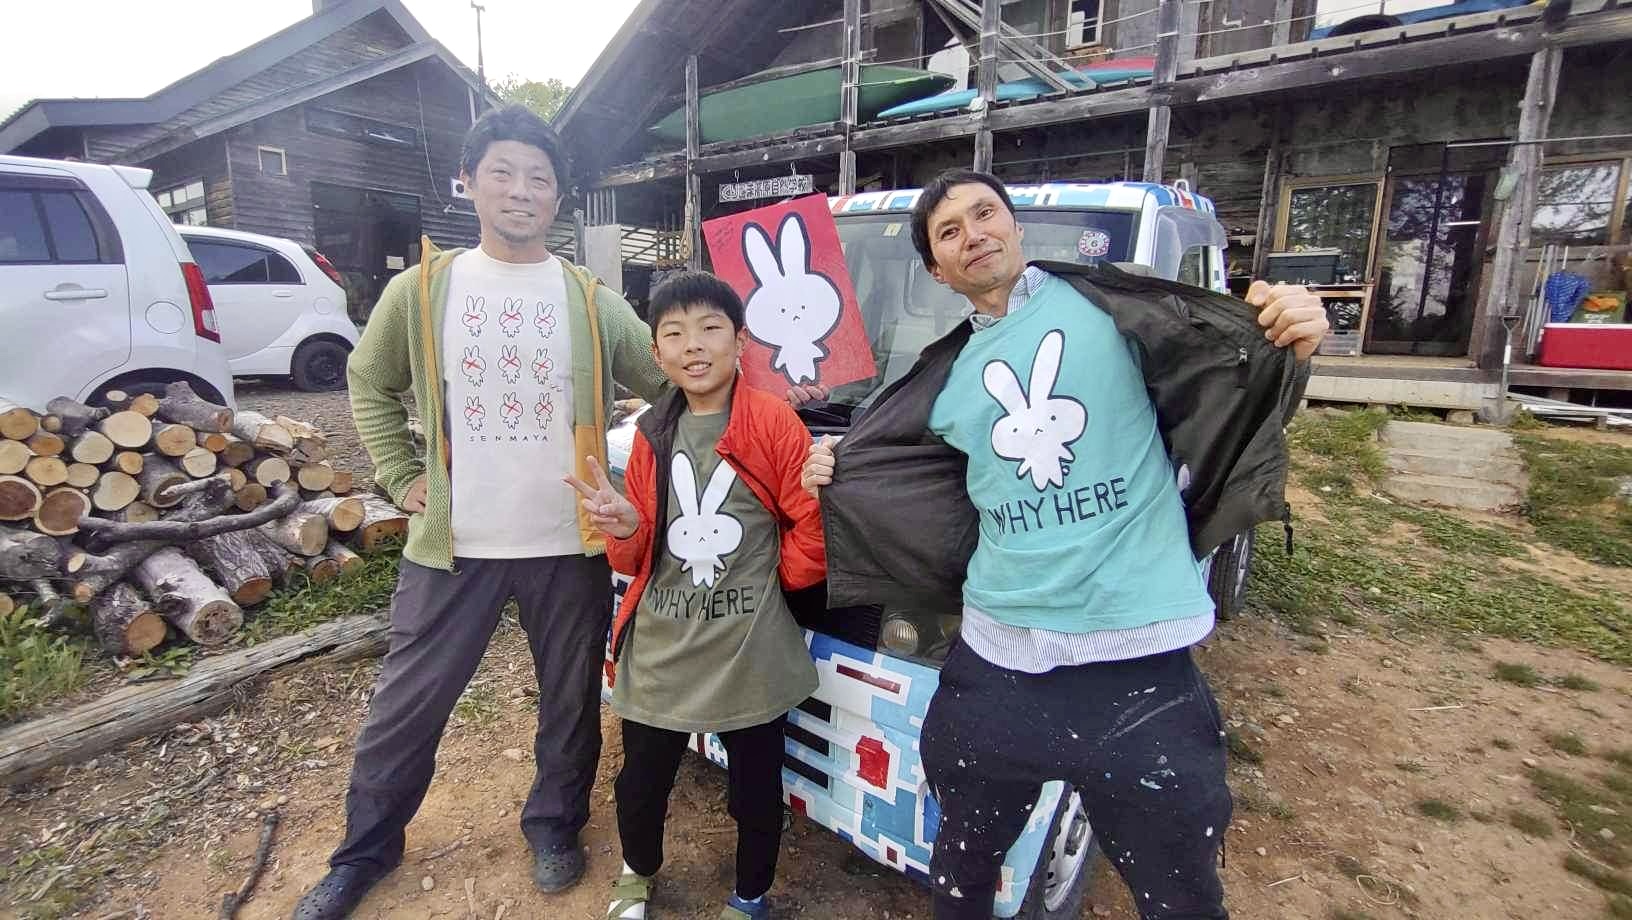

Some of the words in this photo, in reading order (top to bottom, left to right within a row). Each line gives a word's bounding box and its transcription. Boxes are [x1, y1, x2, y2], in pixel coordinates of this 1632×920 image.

[469, 433, 549, 442] SENMAYA
[987, 496, 1046, 535] WHY
[1053, 477, 1128, 526] HERE
[653, 587, 696, 618] WHY
[697, 586, 755, 620] HERE
